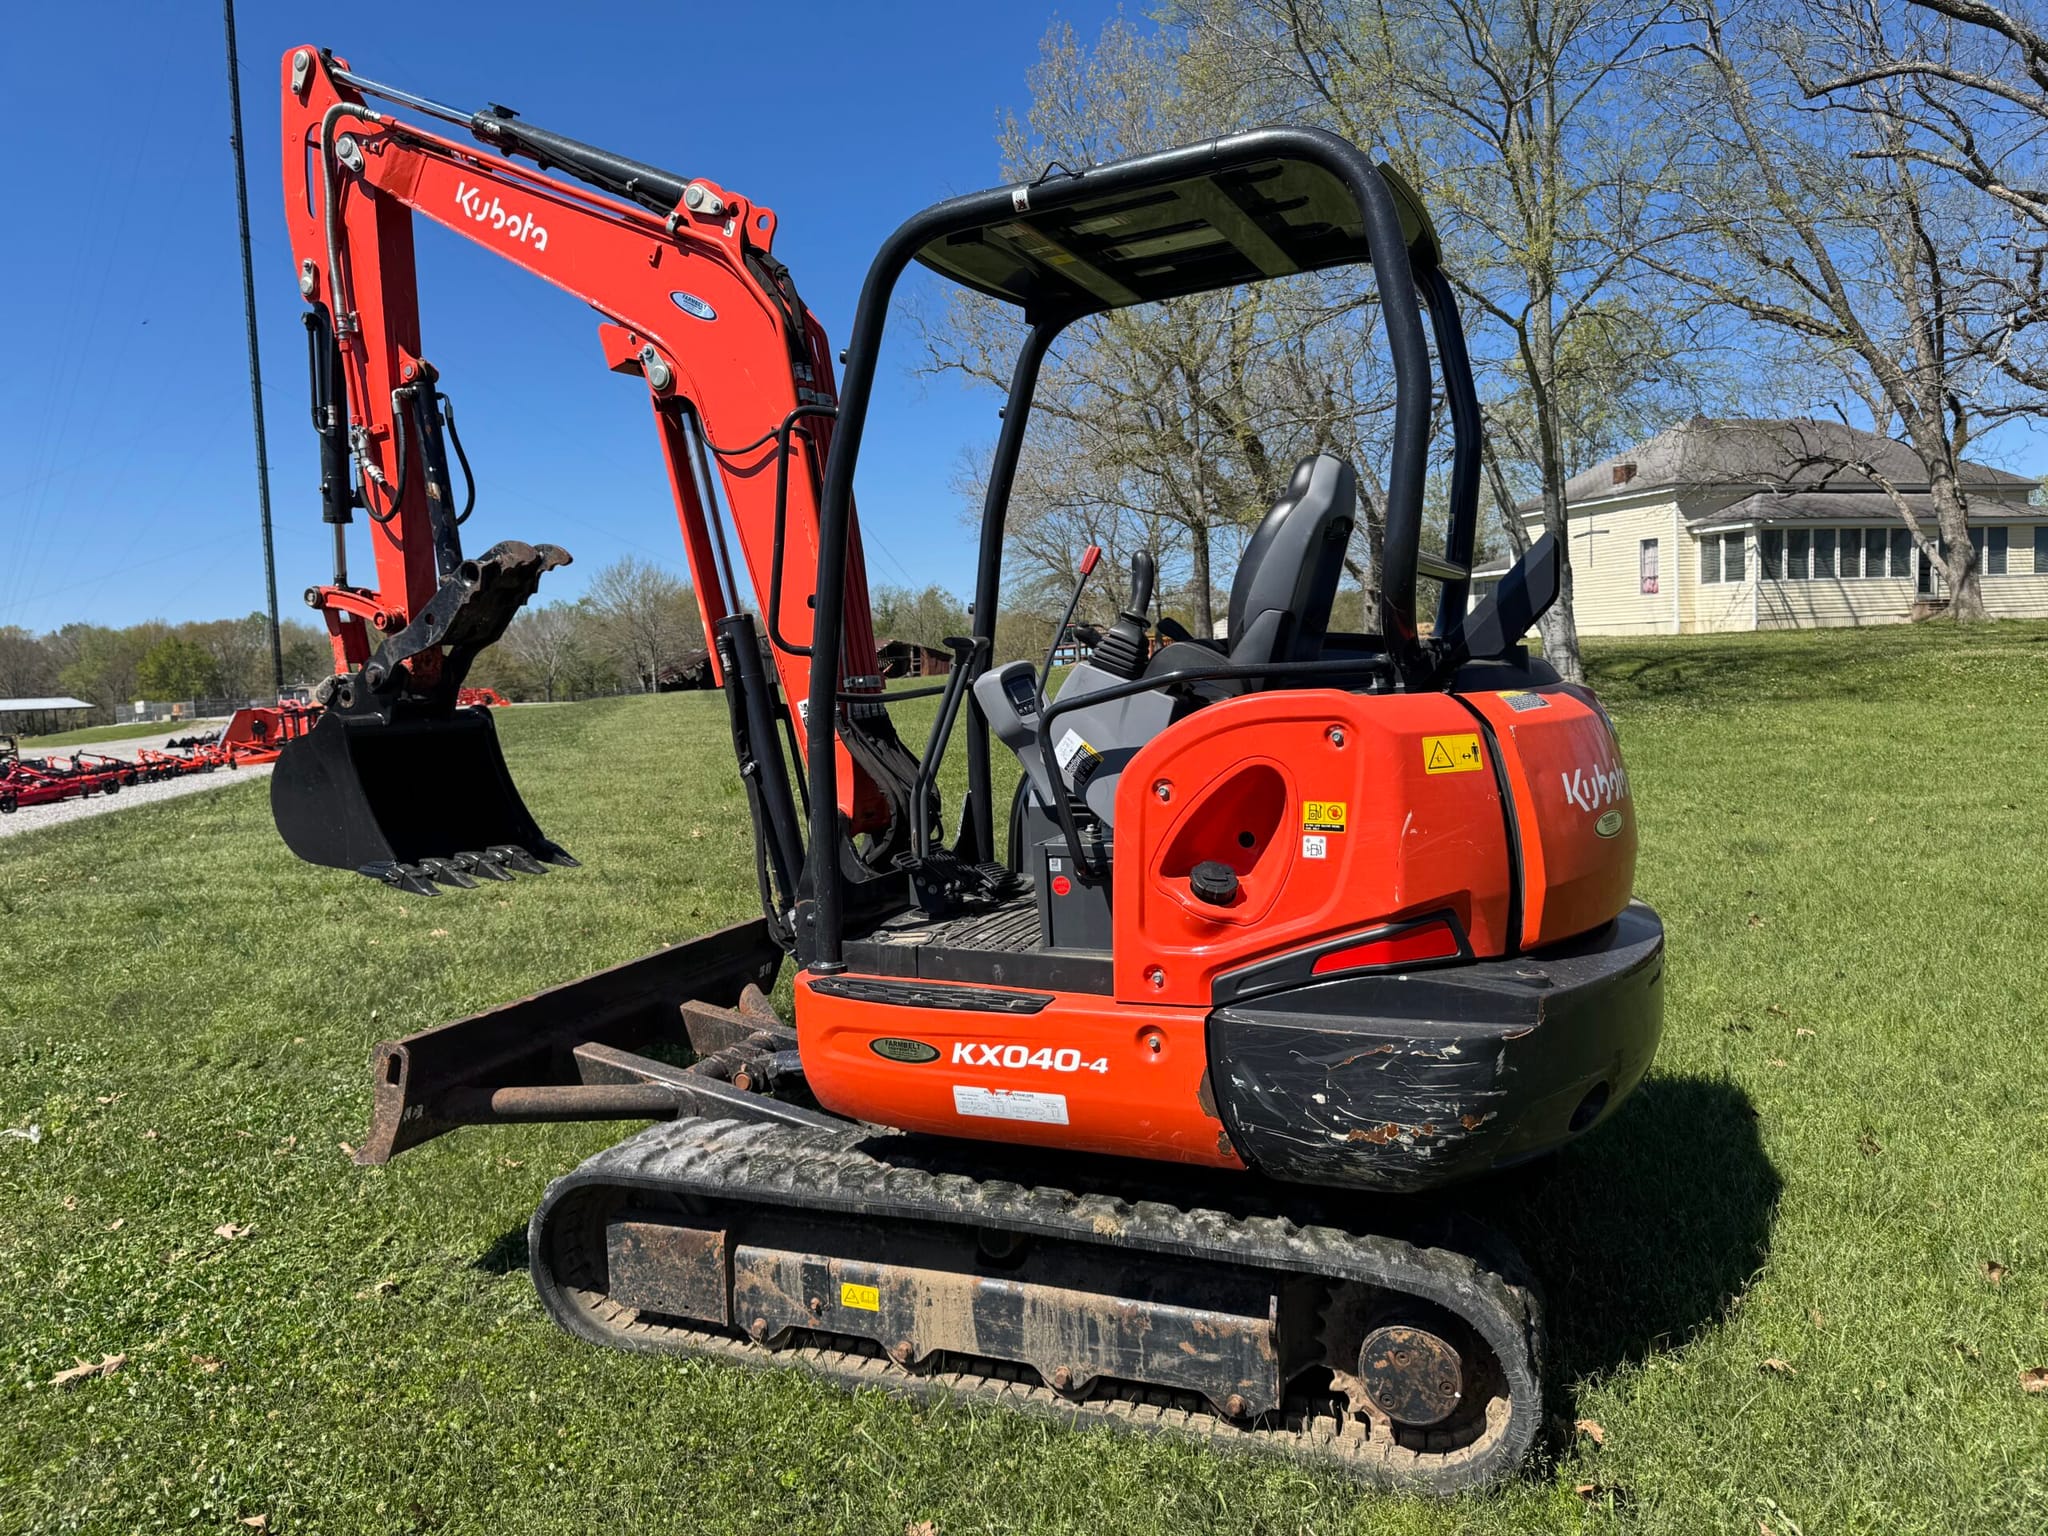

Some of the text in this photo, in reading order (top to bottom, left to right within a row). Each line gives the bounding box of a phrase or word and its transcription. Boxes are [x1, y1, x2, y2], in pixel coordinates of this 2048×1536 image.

[455, 181, 548, 252] Kubota
[885, 1039, 921, 1050] FARMBELT
[951, 1042, 1109, 1074] KX040-4
